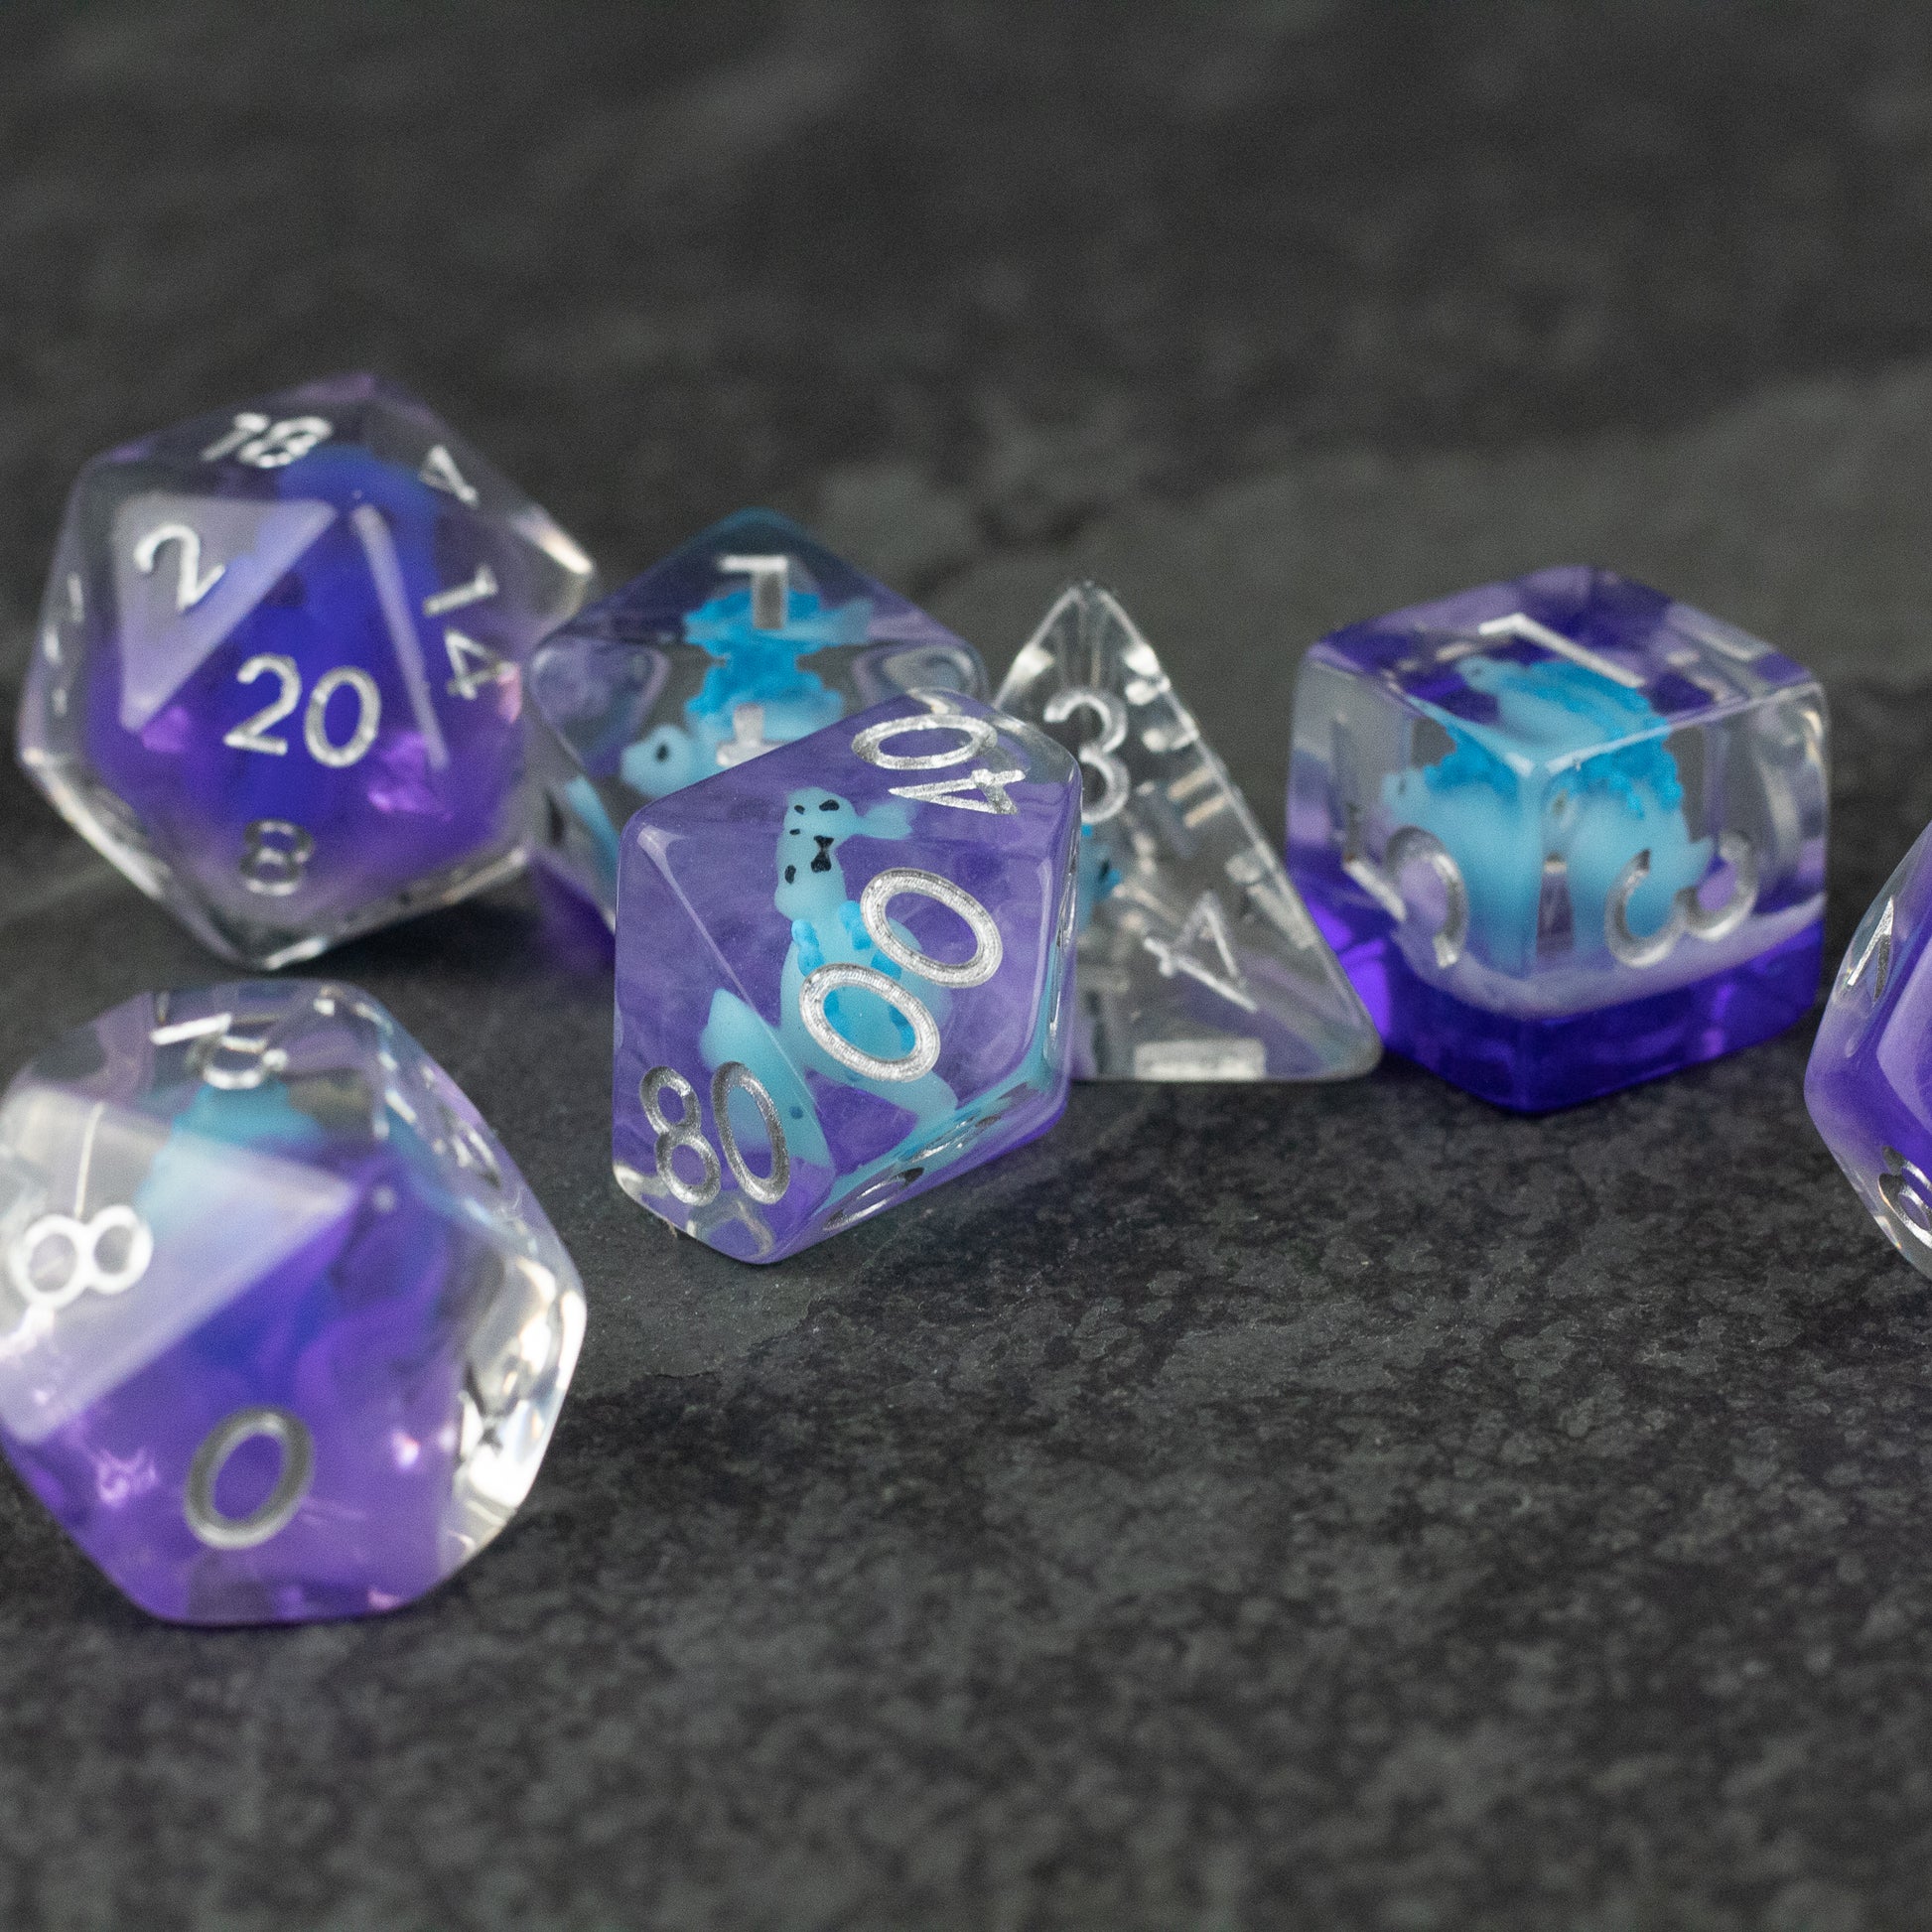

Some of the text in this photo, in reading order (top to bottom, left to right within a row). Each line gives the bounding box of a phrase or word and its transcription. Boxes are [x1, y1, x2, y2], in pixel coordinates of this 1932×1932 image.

[132, 523, 226, 610] 2
[224, 654, 381, 767] 20
[851, 712, 1027, 816] 40
[1044, 688, 1129, 824] 3
[239, 819, 316, 896] 8
[798, 867, 1004, 1083] 00
[638, 1061, 791, 1207] 80
[10, 1204, 155, 1313] 8
[184, 1405, 316, 1551] 0
